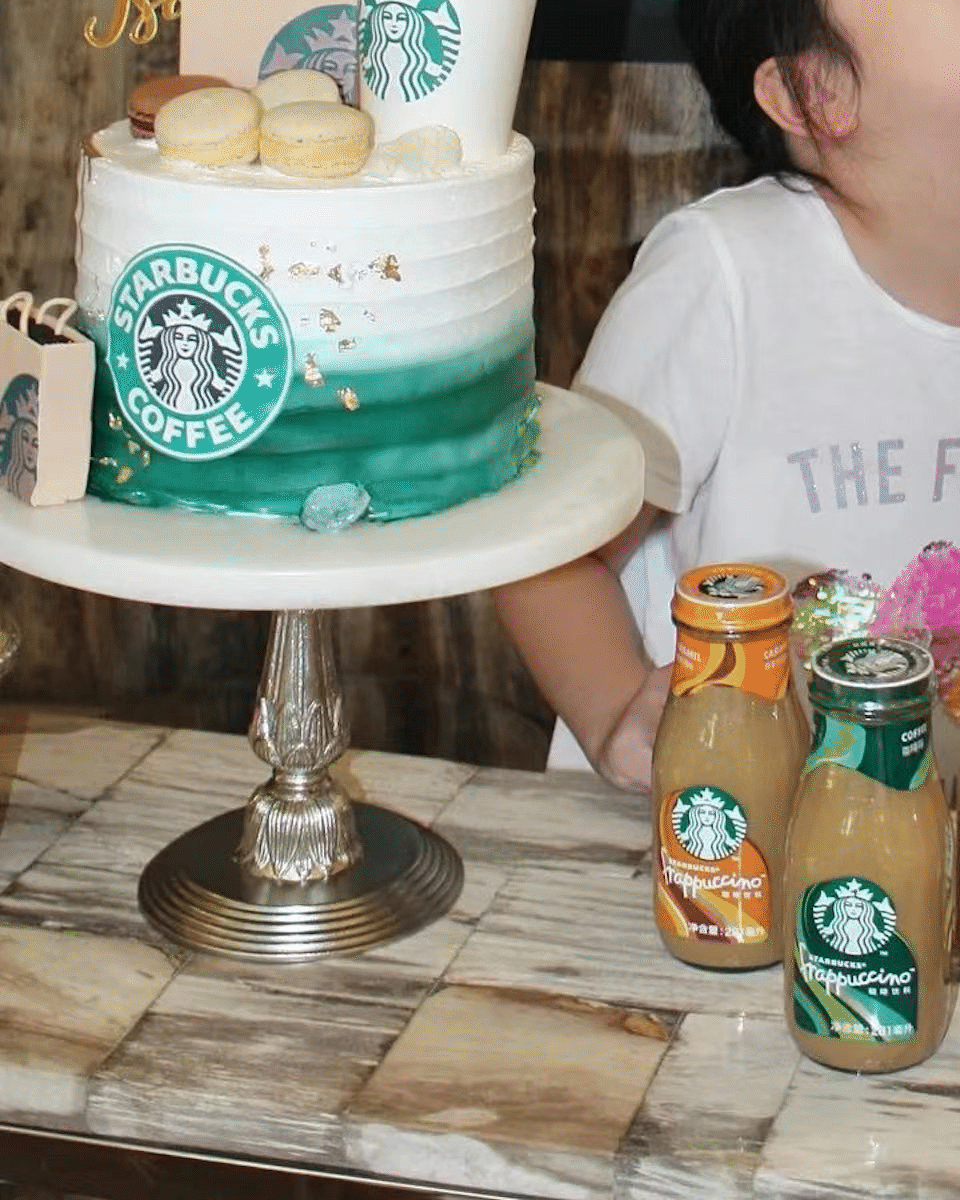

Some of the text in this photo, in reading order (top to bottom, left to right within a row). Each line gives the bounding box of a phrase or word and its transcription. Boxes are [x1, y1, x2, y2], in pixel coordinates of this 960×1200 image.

[114, 256, 280, 349] STARBUCKS
[128, 386, 256, 449] COFFEE
[786, 438, 906, 514] THE
